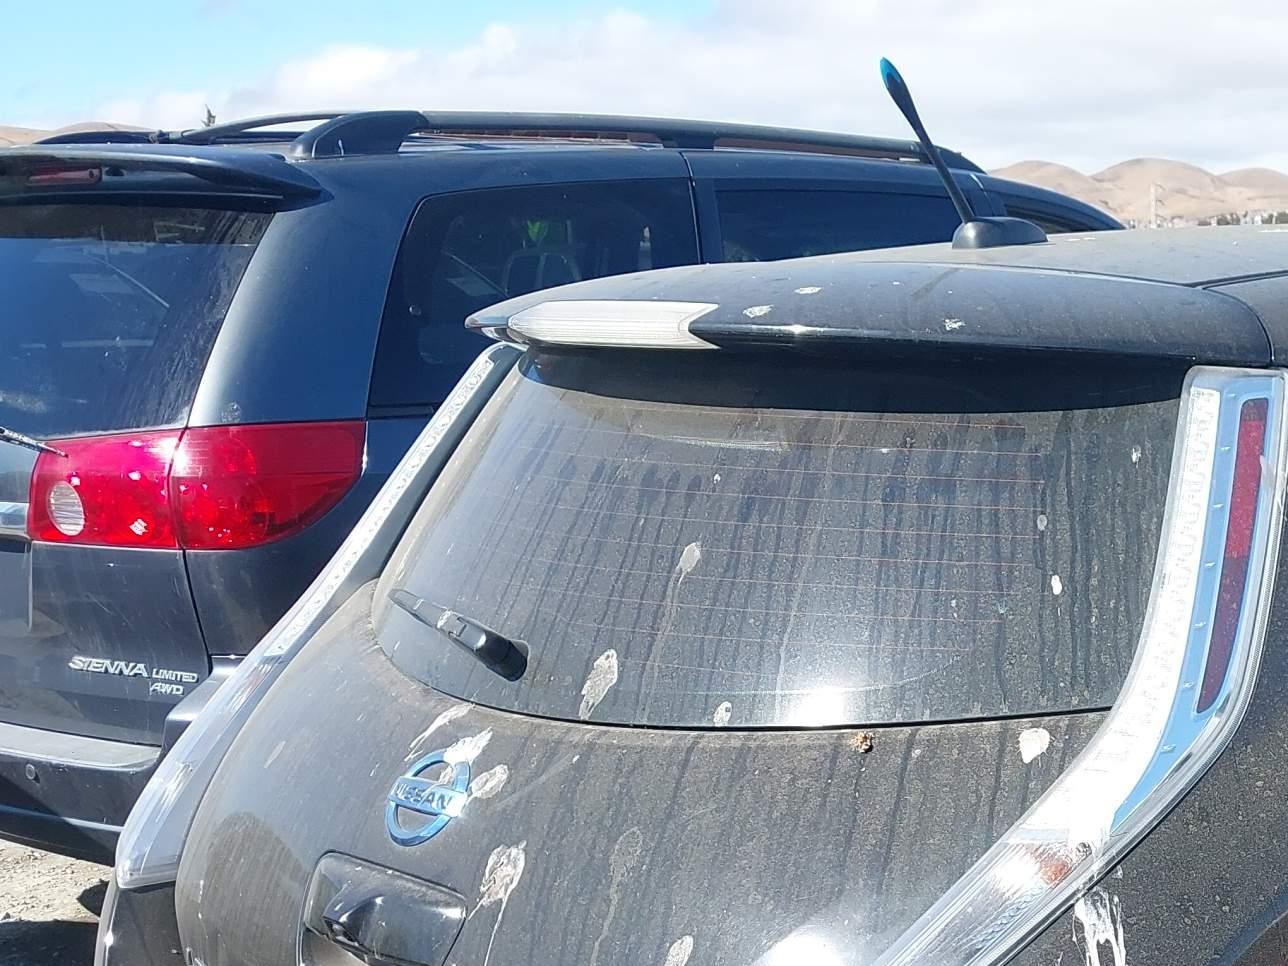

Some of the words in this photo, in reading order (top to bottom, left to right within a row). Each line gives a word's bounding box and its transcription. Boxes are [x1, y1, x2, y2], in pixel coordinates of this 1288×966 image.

[68, 655, 149, 678] SIENNA
[152, 668, 199, 683] LIMITED
[151, 682, 184, 695] AWD
[390, 782, 453, 810] NISSAN
